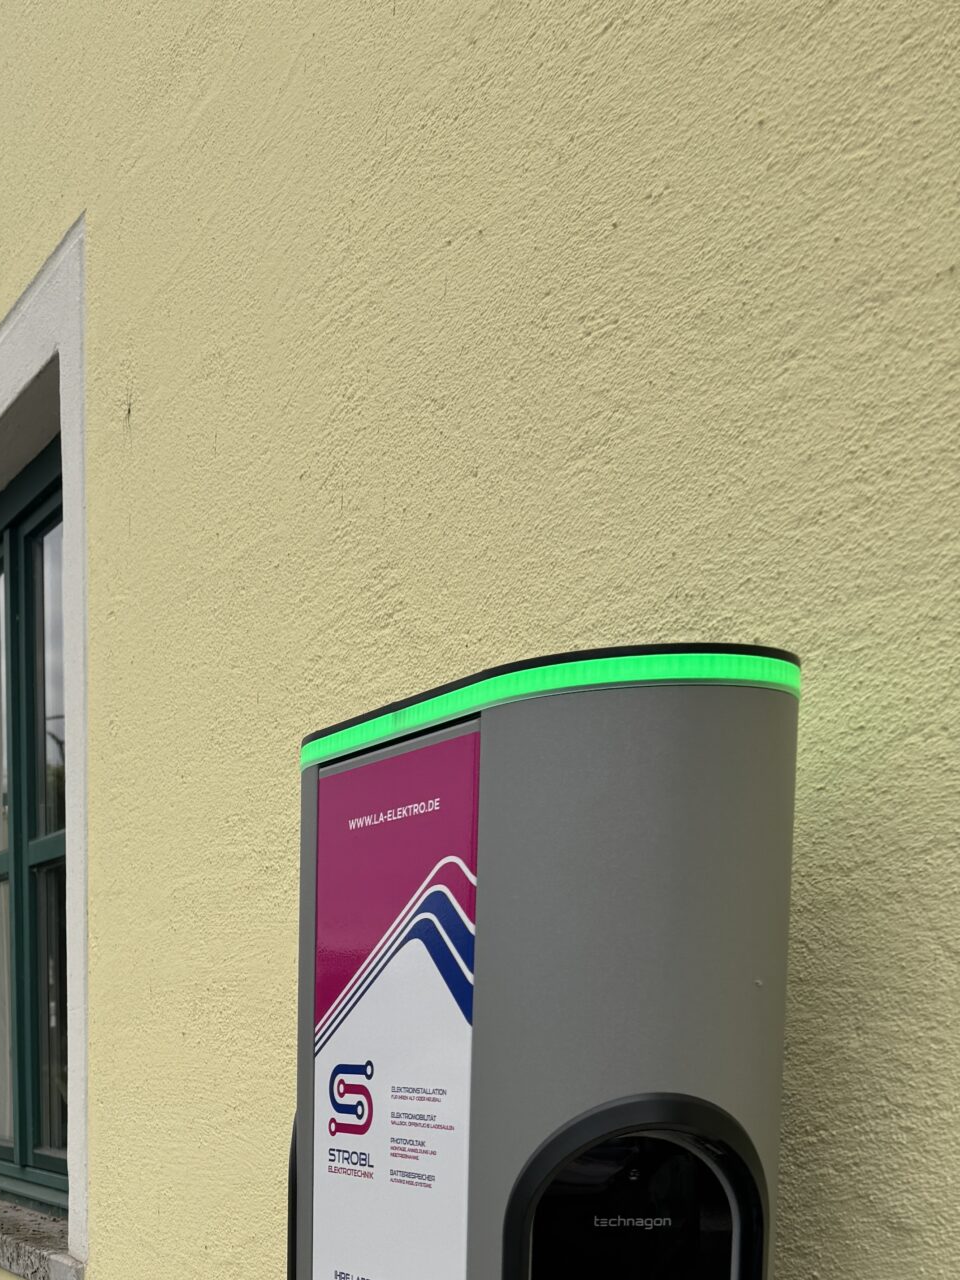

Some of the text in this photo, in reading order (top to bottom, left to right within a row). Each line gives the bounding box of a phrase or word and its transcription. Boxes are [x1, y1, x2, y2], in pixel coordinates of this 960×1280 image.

[348, 798, 440, 830] WWW.LA-ELEKTRO.DE
[391, 1086, 447, 1096] ELEKTROINSTALLATION
[390, 1112, 437, 1121] ELEKTROMOBILITÄT
[390, 1137, 426, 1147] PHOTOVOLTAIK
[328, 1148, 374, 1168] STROBL
[328, 1165, 374, 1180] ELEKTROTECHNIK
[594, 1215, 672, 1230] technagon
